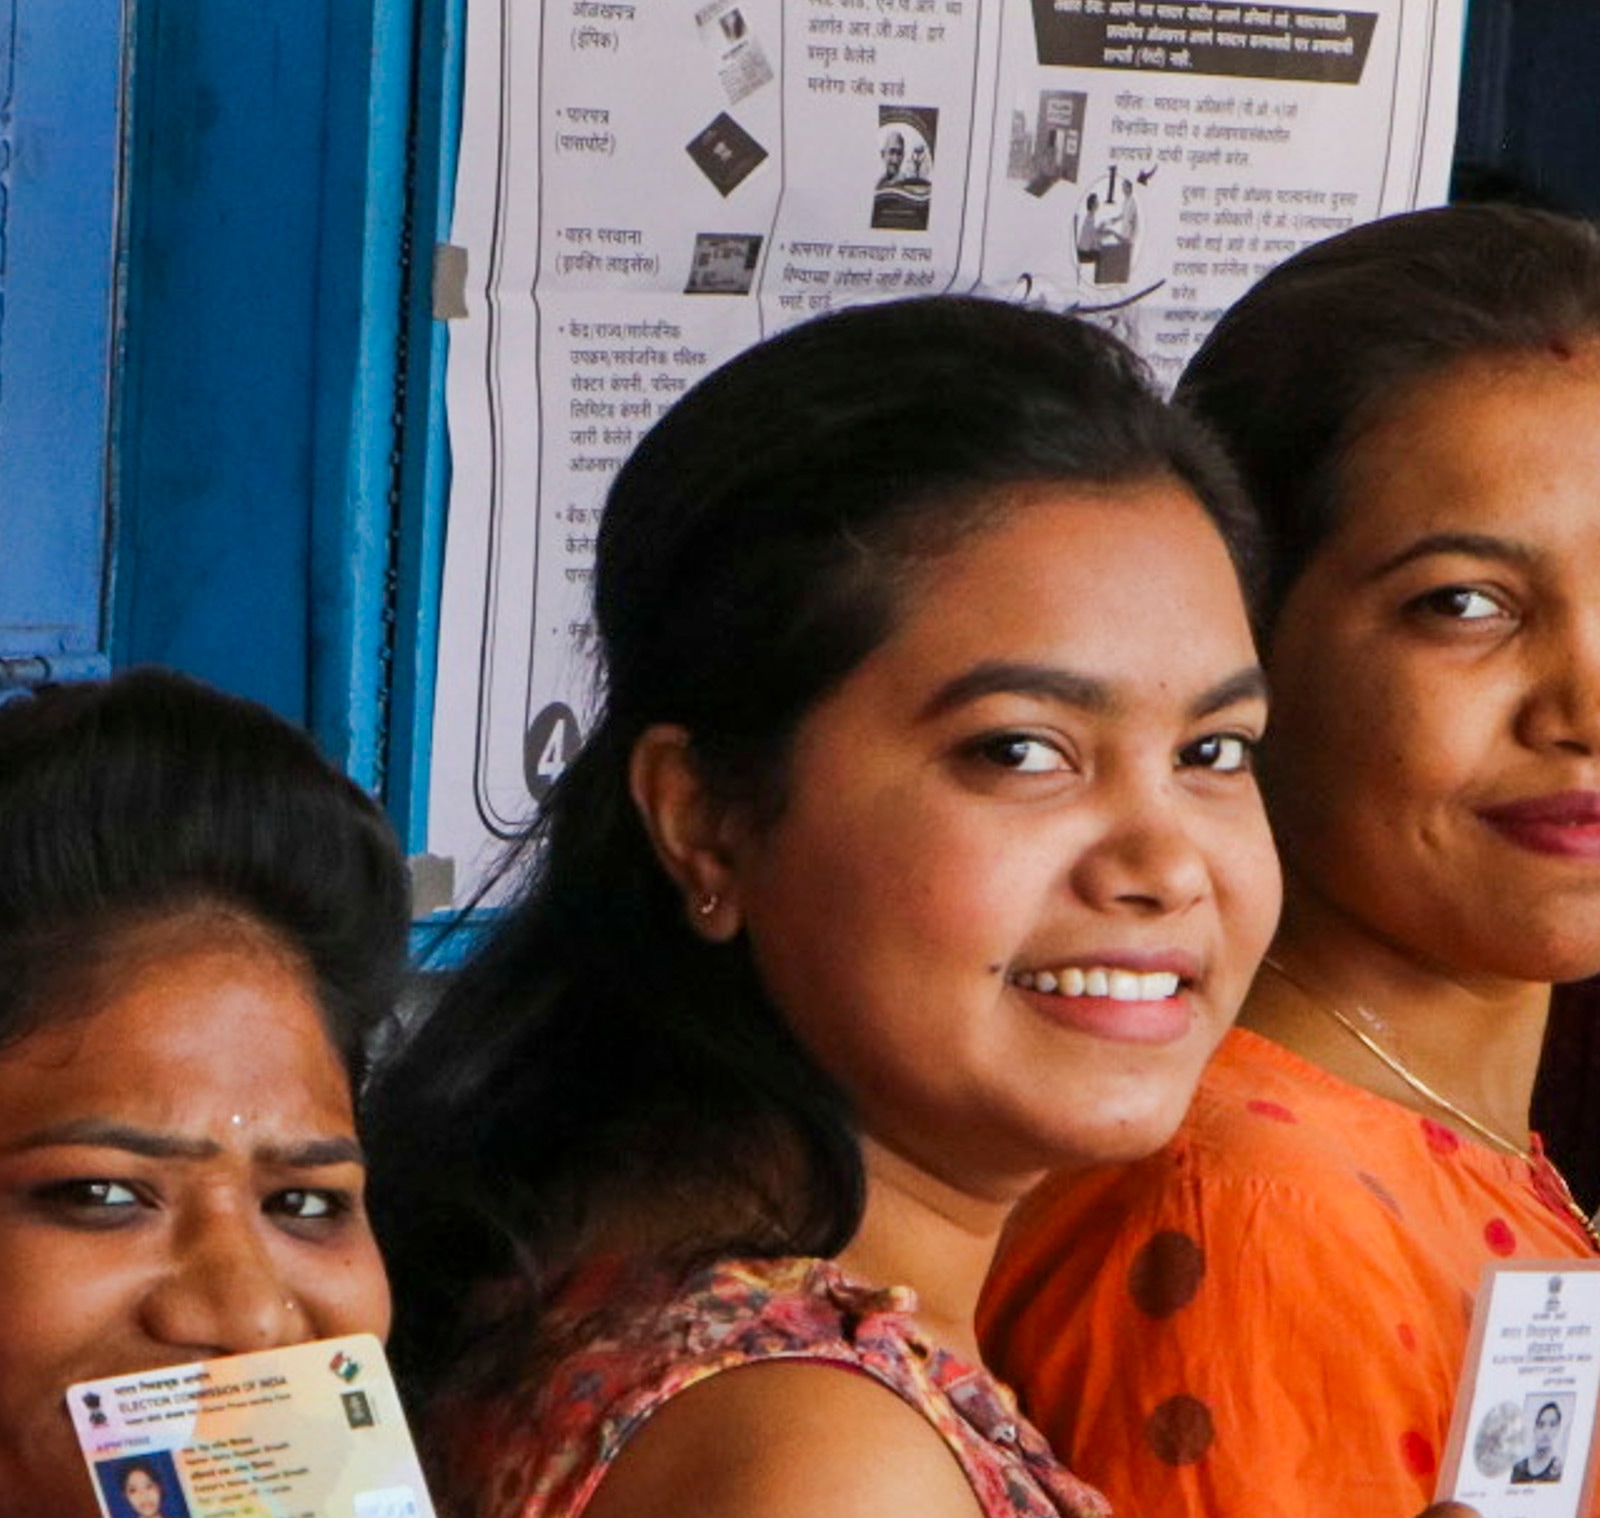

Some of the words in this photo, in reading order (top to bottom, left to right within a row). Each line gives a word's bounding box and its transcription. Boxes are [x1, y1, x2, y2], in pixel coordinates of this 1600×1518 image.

[597, 229, 642, 245] परवाना
[537, 718, 566, 785] 4
[119, 1394, 172, 1413] ELECTION
[259, 1375, 287, 1390] INDIA
